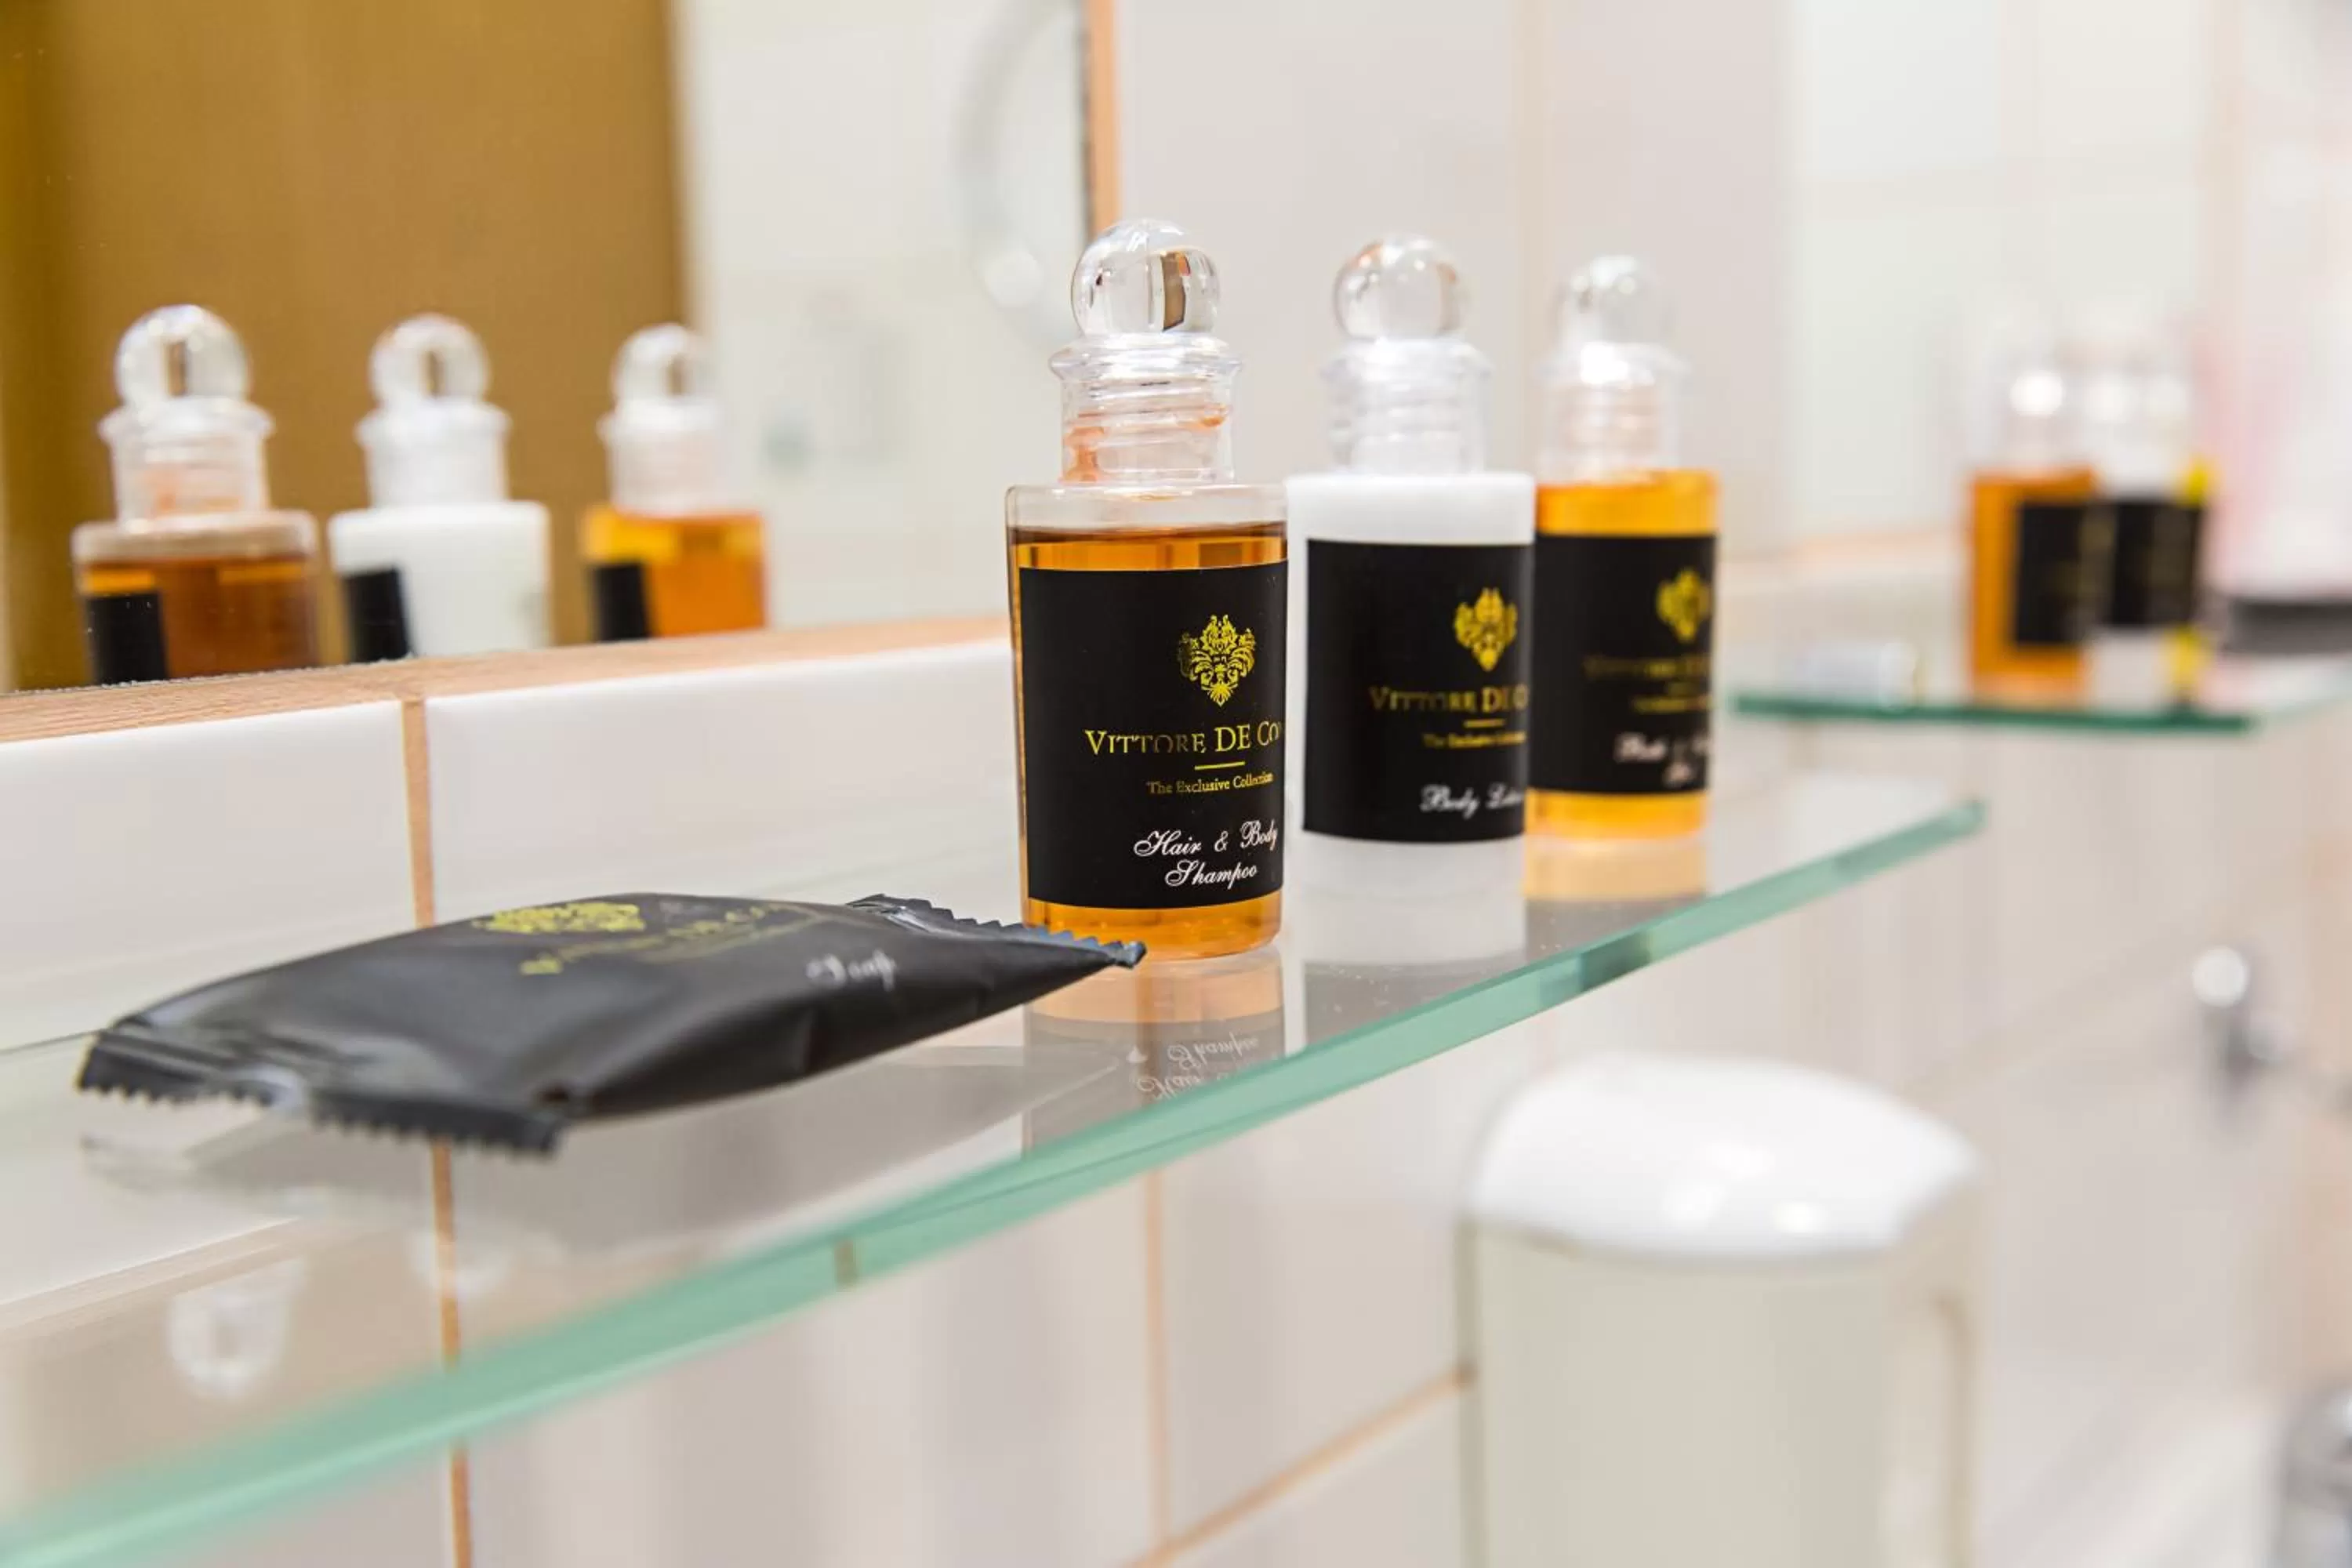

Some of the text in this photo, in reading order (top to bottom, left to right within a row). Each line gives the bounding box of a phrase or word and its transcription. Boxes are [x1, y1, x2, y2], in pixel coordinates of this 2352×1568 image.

[1084, 720, 1282, 756] VITTORE DE CO
[1147, 781, 1174, 795] The
[1176, 777, 1230, 793] Exclusive
[1134, 818, 1279, 858] Hair & Body
[1164, 858, 1258, 891] Shampoo
